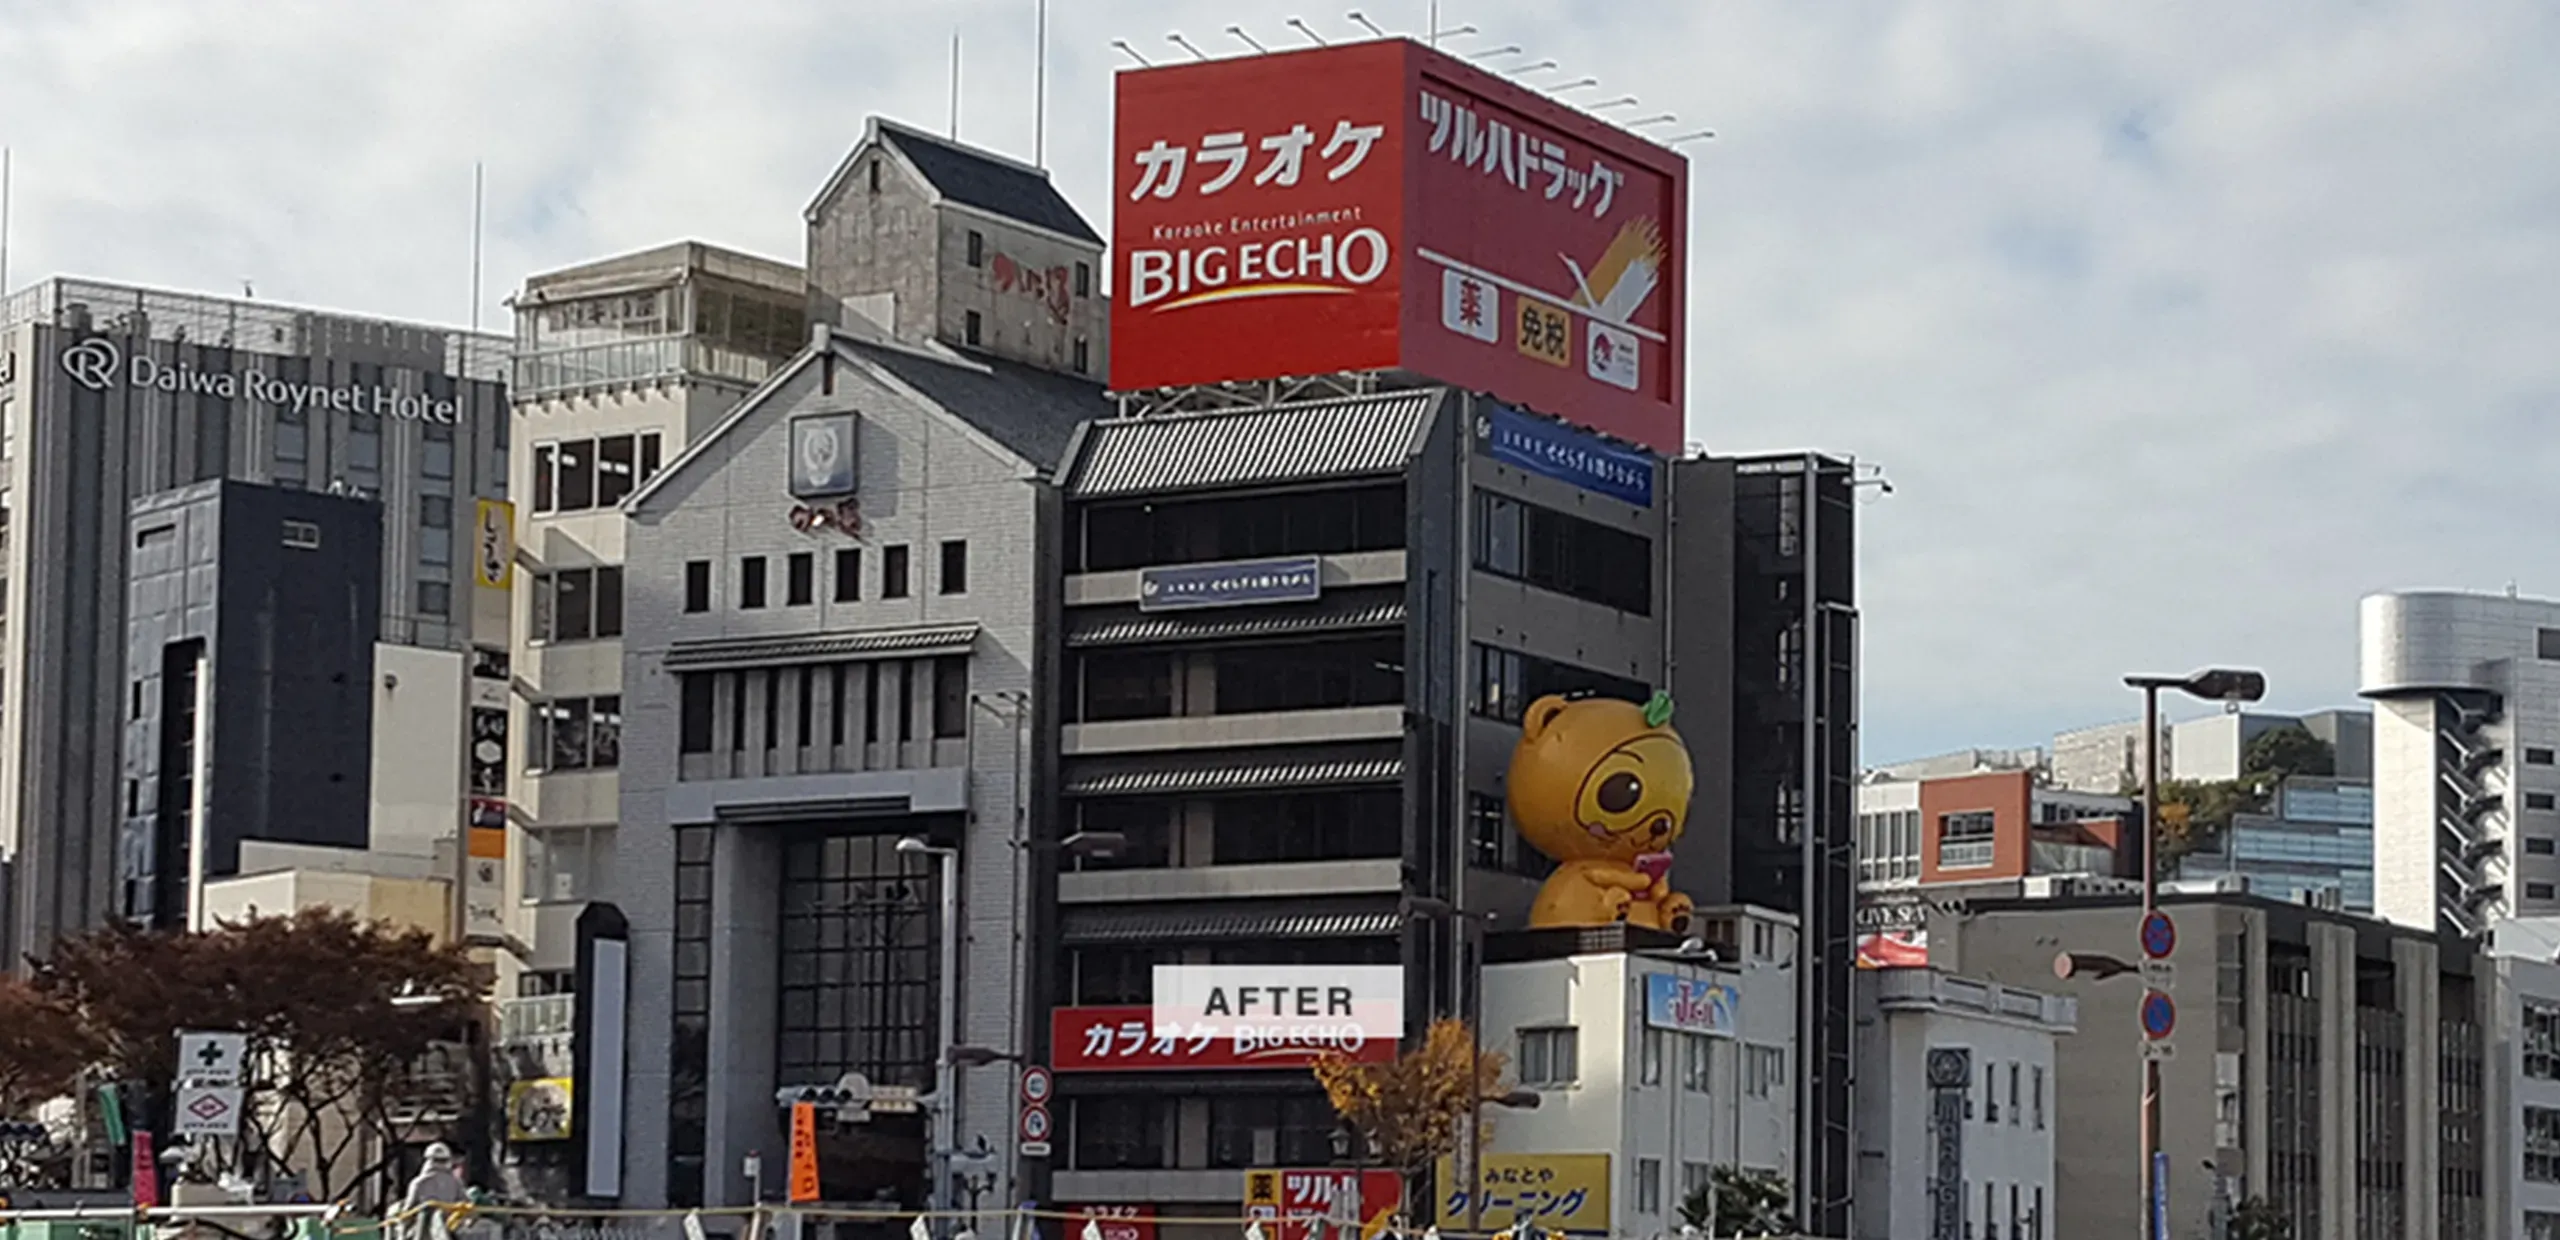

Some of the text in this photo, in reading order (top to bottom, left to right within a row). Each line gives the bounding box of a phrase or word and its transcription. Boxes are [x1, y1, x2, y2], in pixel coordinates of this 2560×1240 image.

[1130, 120, 1384, 201] カラオケ
[1420, 91, 1624, 218] ツルハドラッグ
[1153, 206, 1362, 240] Karaoke Entertainment
[1130, 247, 1228, 308] BIG
[1239, 228, 1389, 284] ECHO
[1460, 278, 1482, 328] 薬
[1521, 305, 1566, 360] 免税
[131, 355, 464, 425] Daiwa Roynet Hotel
[1082, 1021, 1221, 1057] カラオケ
[1233, 1021, 1366, 1055] BIG ECHO
[1484, 1167, 1554, 1184] みなとや
